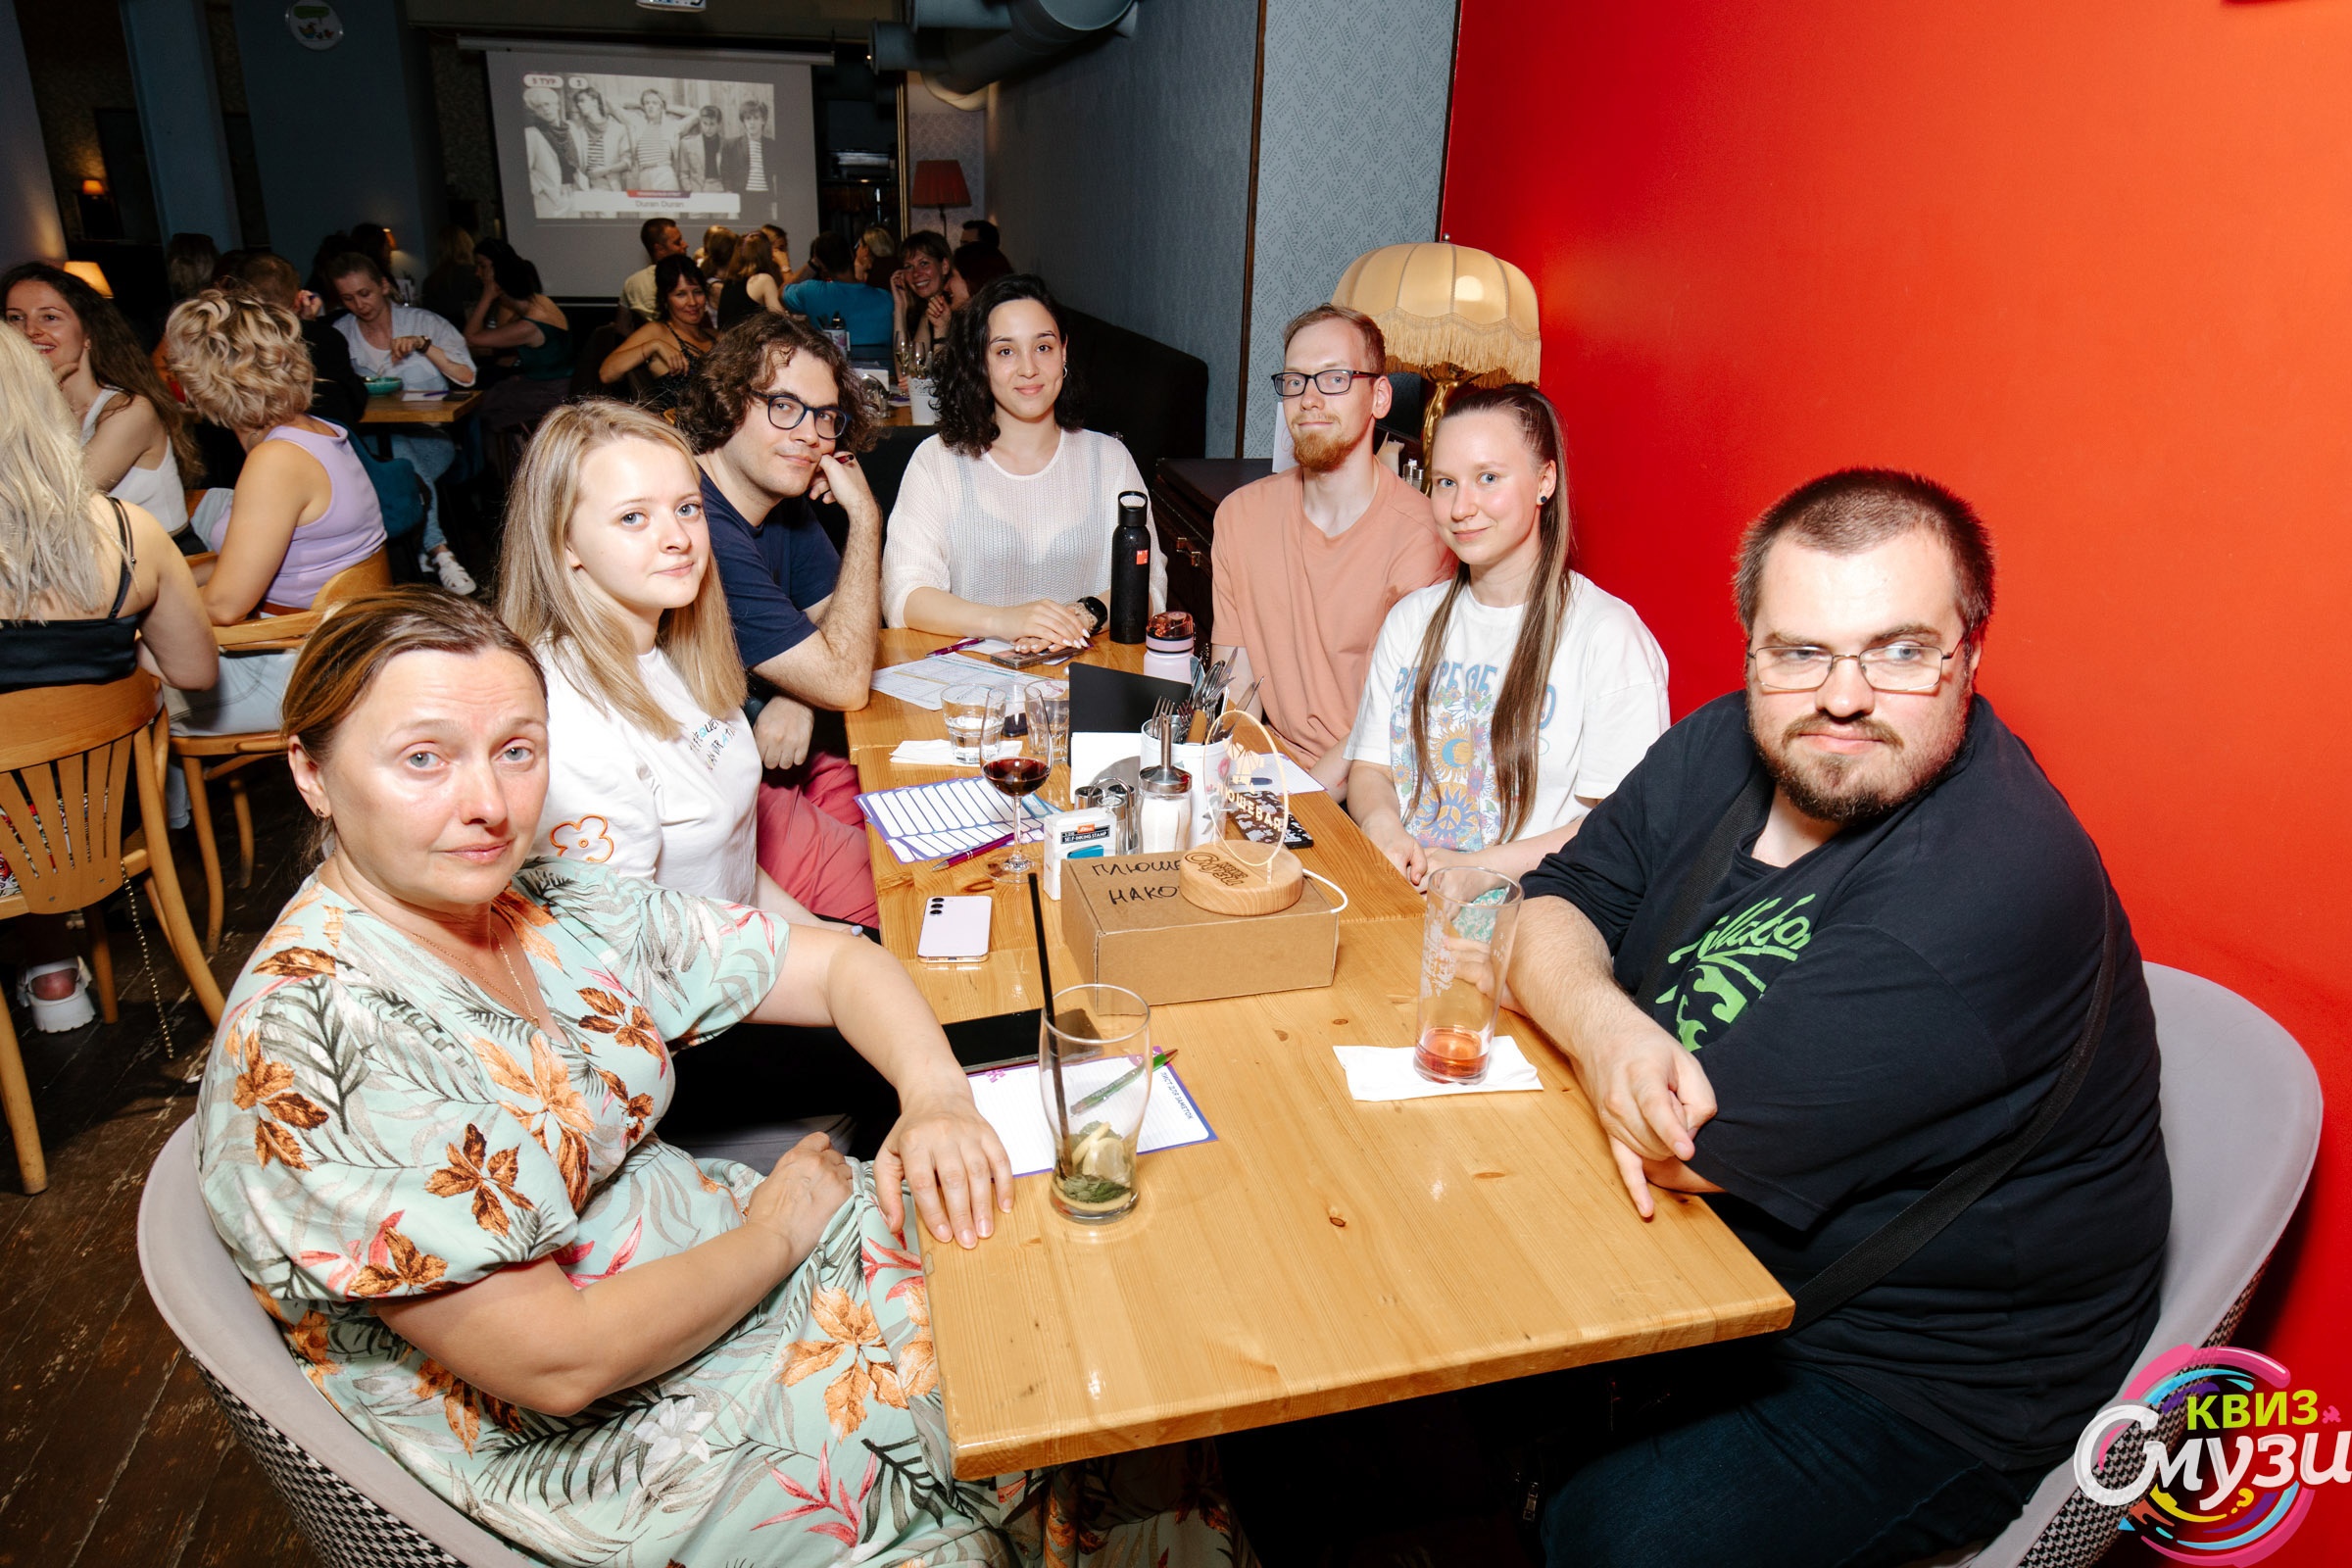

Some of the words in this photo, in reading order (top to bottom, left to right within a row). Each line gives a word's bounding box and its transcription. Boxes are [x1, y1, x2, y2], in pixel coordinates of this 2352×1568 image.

[1108, 885, 1180, 905] НАКО
[1160, 1072, 1173, 1087] ЛИСТ
[1175, 1096, 1194, 1119] ЗАМЕТОК
